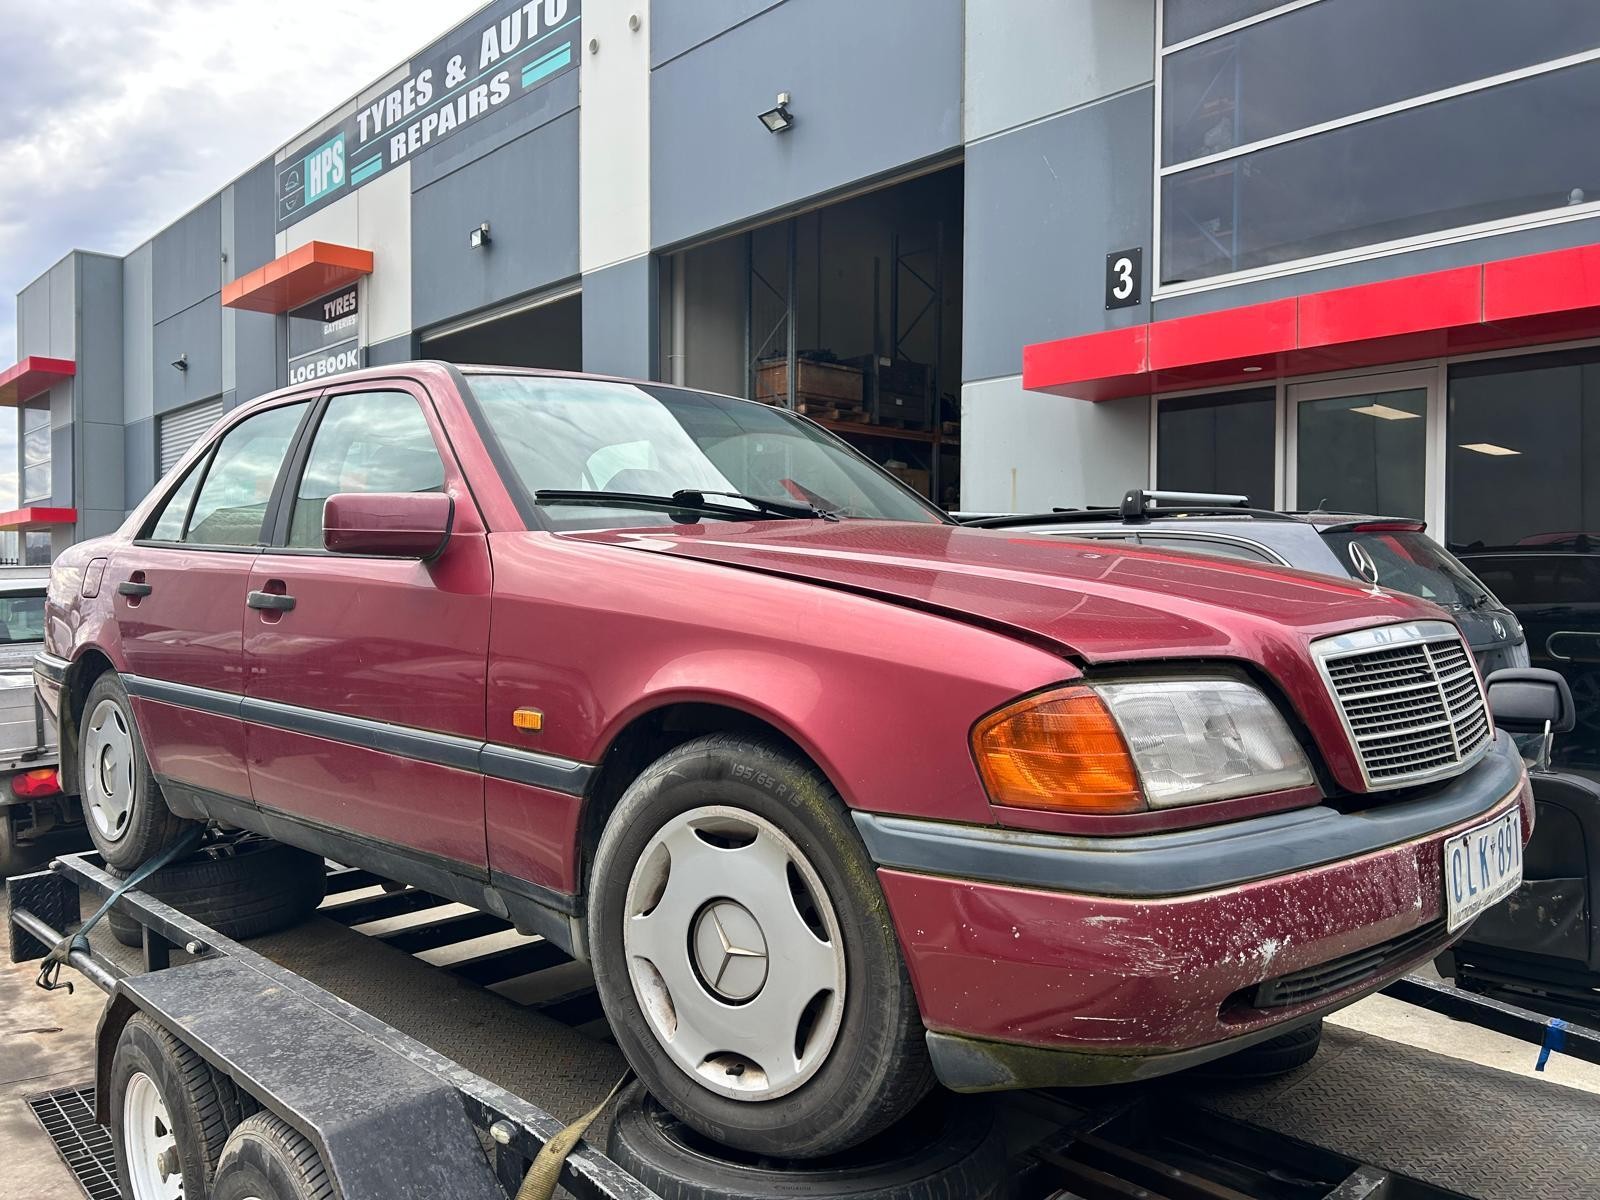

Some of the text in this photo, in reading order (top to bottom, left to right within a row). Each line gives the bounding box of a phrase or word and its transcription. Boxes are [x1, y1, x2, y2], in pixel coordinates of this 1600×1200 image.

[357, 0, 568, 143] TYRES & AUTO
[390, 71, 511, 164] REPAIRS
[310, 140, 344, 198] HPS
[1112, 257, 1134, 300] 3
[323, 291, 356, 320] TYRES
[290, 348, 358, 385] LOG BOOK
[731, 762, 776, 788] 195/65
